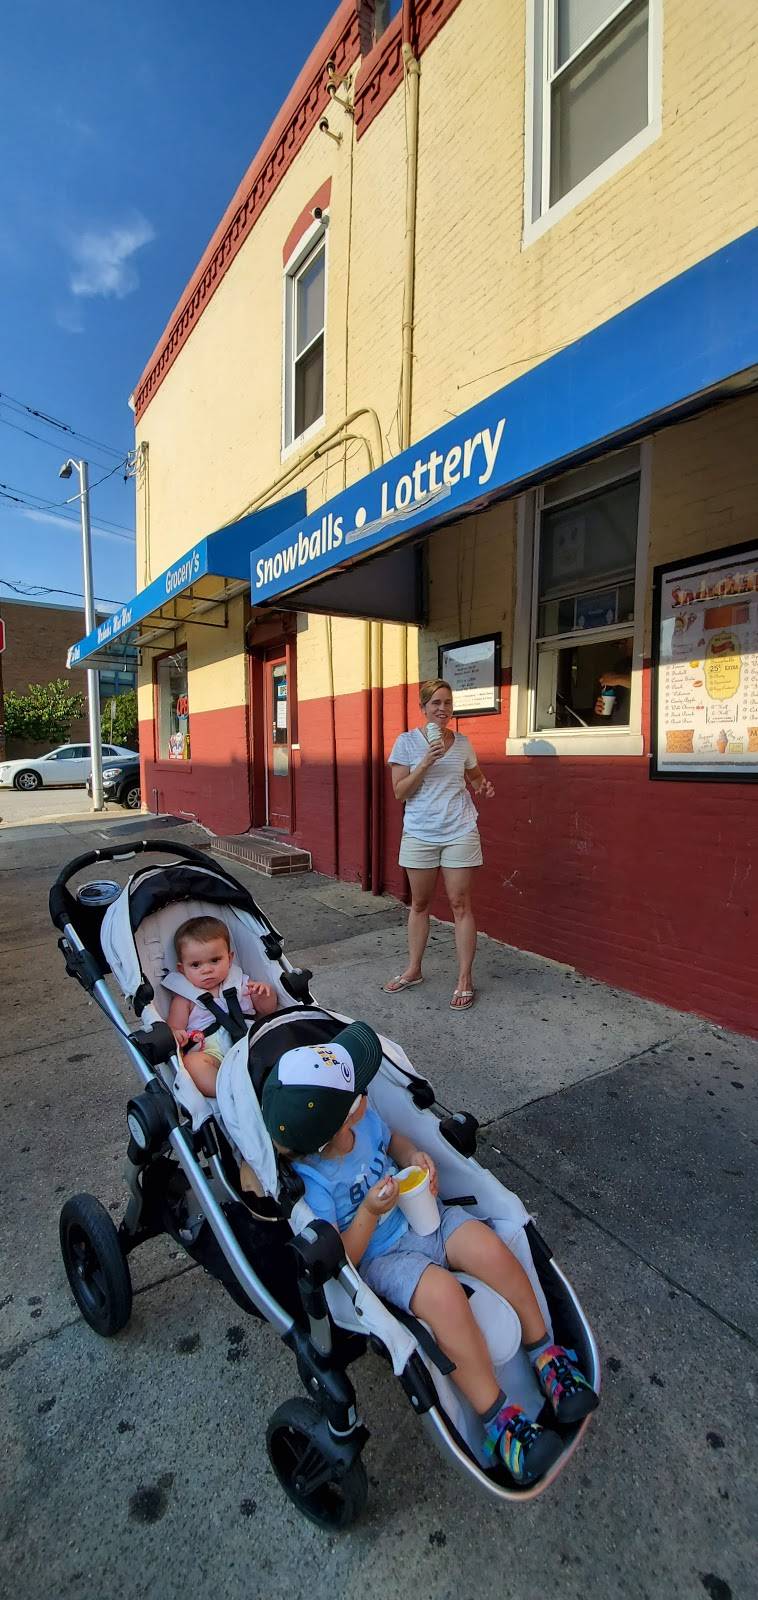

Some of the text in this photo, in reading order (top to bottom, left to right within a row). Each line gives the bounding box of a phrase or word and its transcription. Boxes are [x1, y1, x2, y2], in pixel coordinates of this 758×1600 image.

[256, 418, 506, 588] Snowballs Lottery
[165, 551, 200, 593] Grocery's
